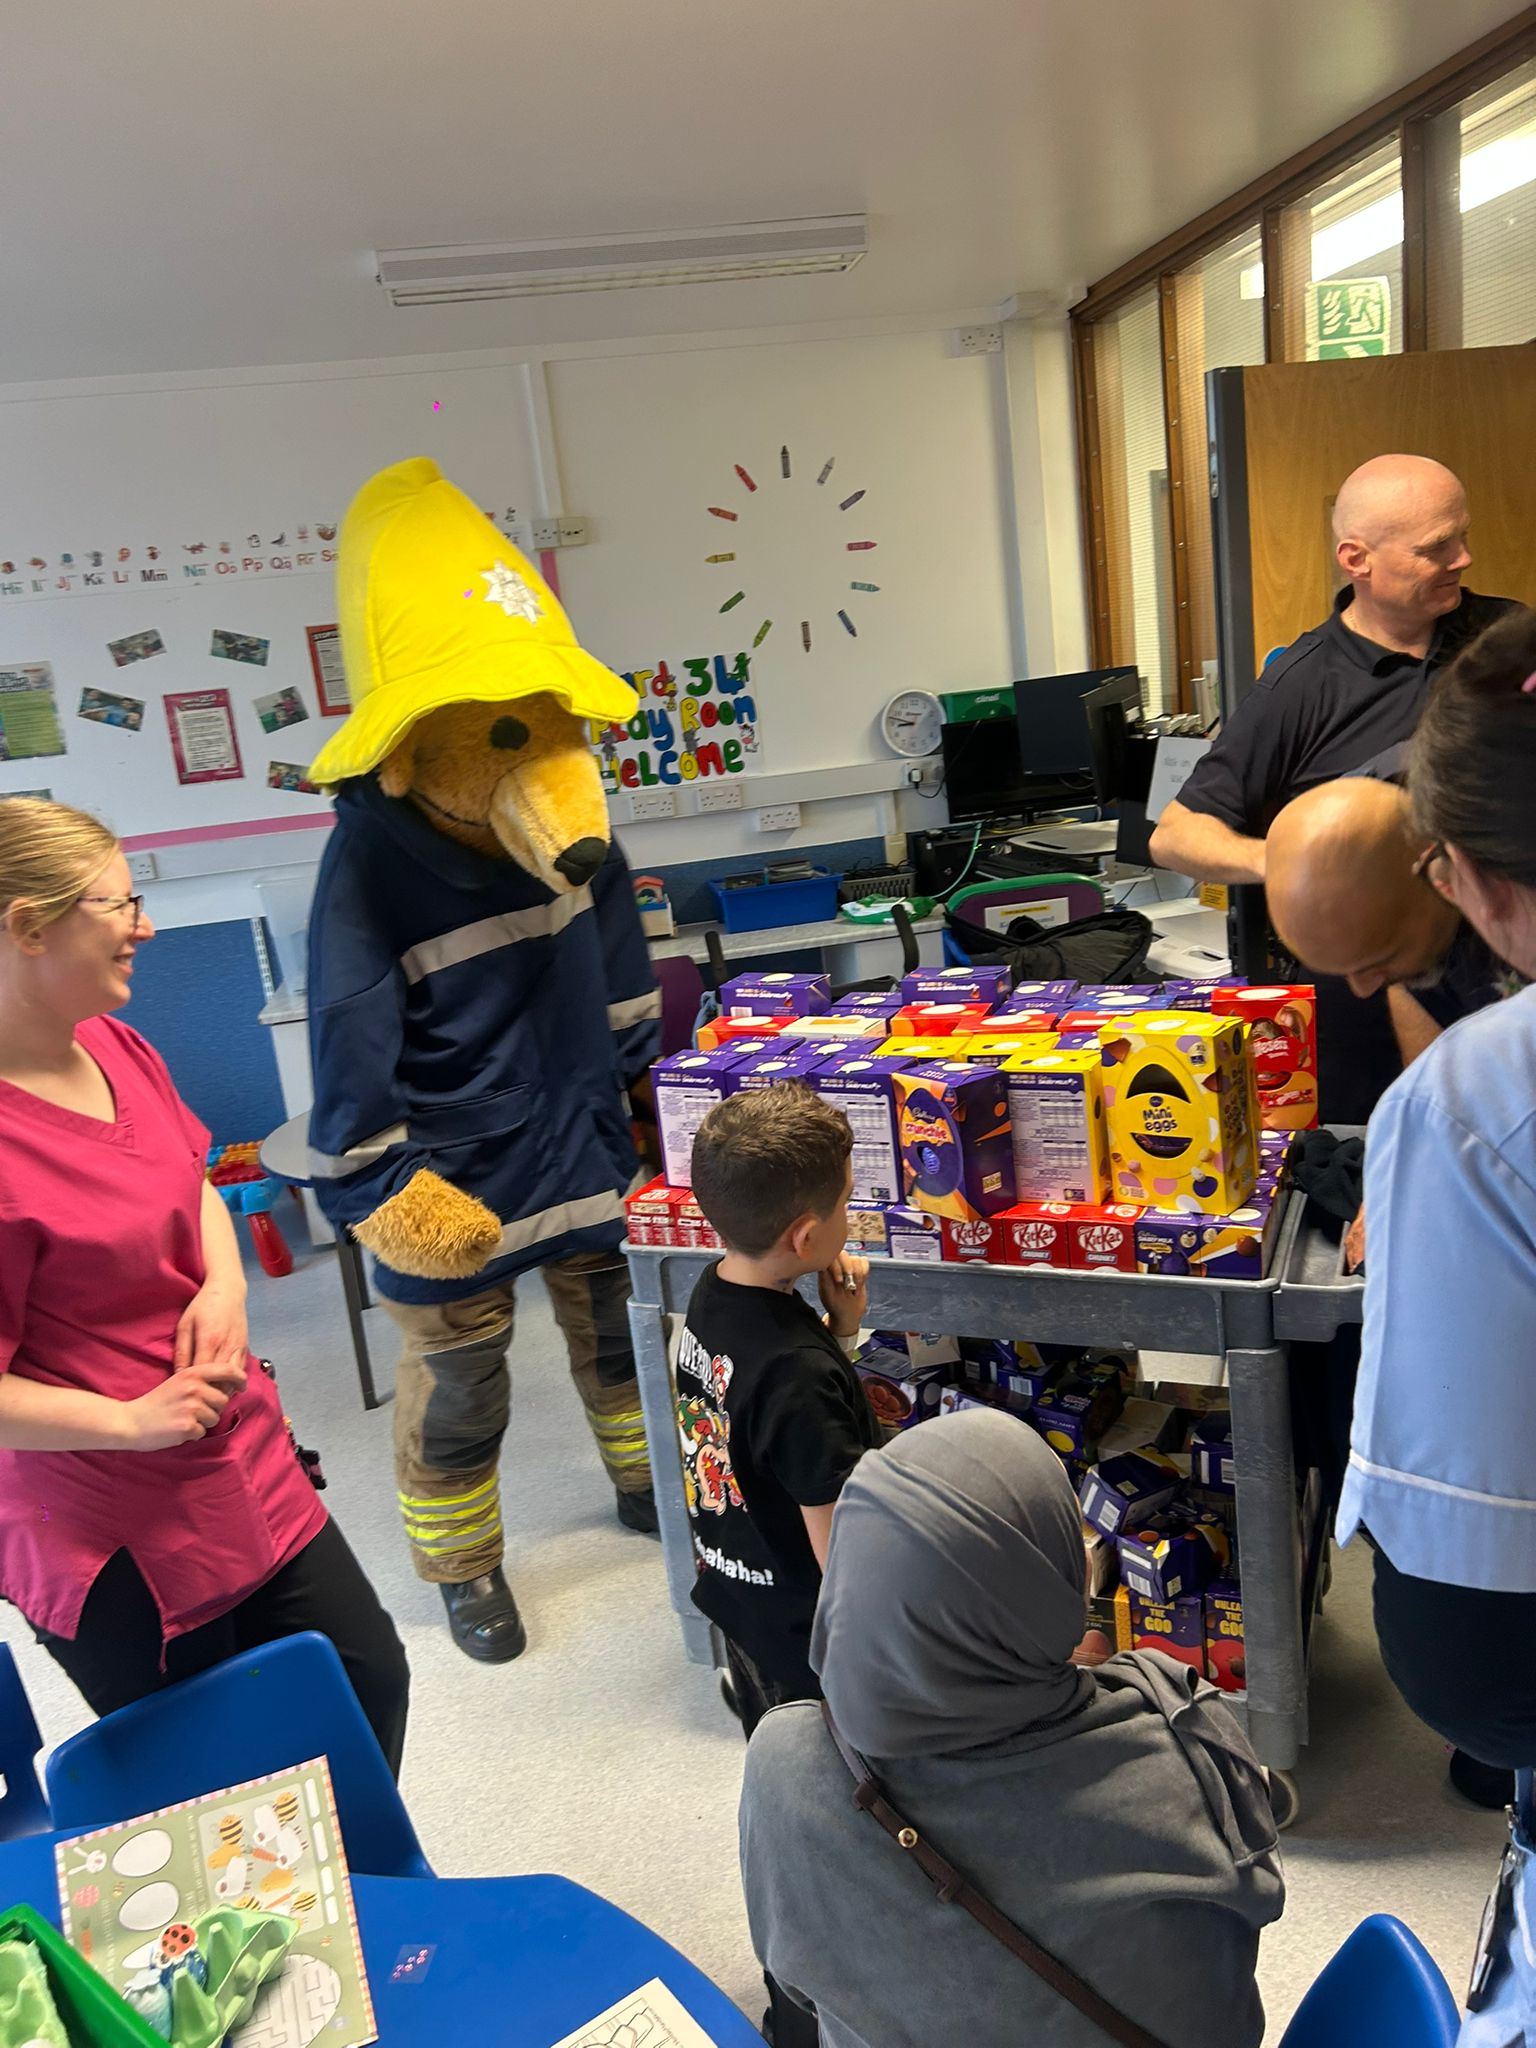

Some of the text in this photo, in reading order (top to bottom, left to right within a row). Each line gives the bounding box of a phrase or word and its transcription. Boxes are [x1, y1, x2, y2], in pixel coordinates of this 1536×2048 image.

[242, 557, 264, 572] Pp
[619, 652, 751, 699] rd 34
[1142, 1106, 1173, 1121] Mini
[1145, 1119, 1178, 1133] eggs
[956, 1220, 992, 1244] KitKat
[1019, 1222, 1055, 1249] KitKat
[1084, 1225, 1122, 1251] KitKat
[1214, 1599, 1243, 1612] UNLEA
[1150, 1608, 1168, 1619] THE
[1225, 1611, 1242, 1622] THE
[1144, 1616, 1174, 1634] GOO
